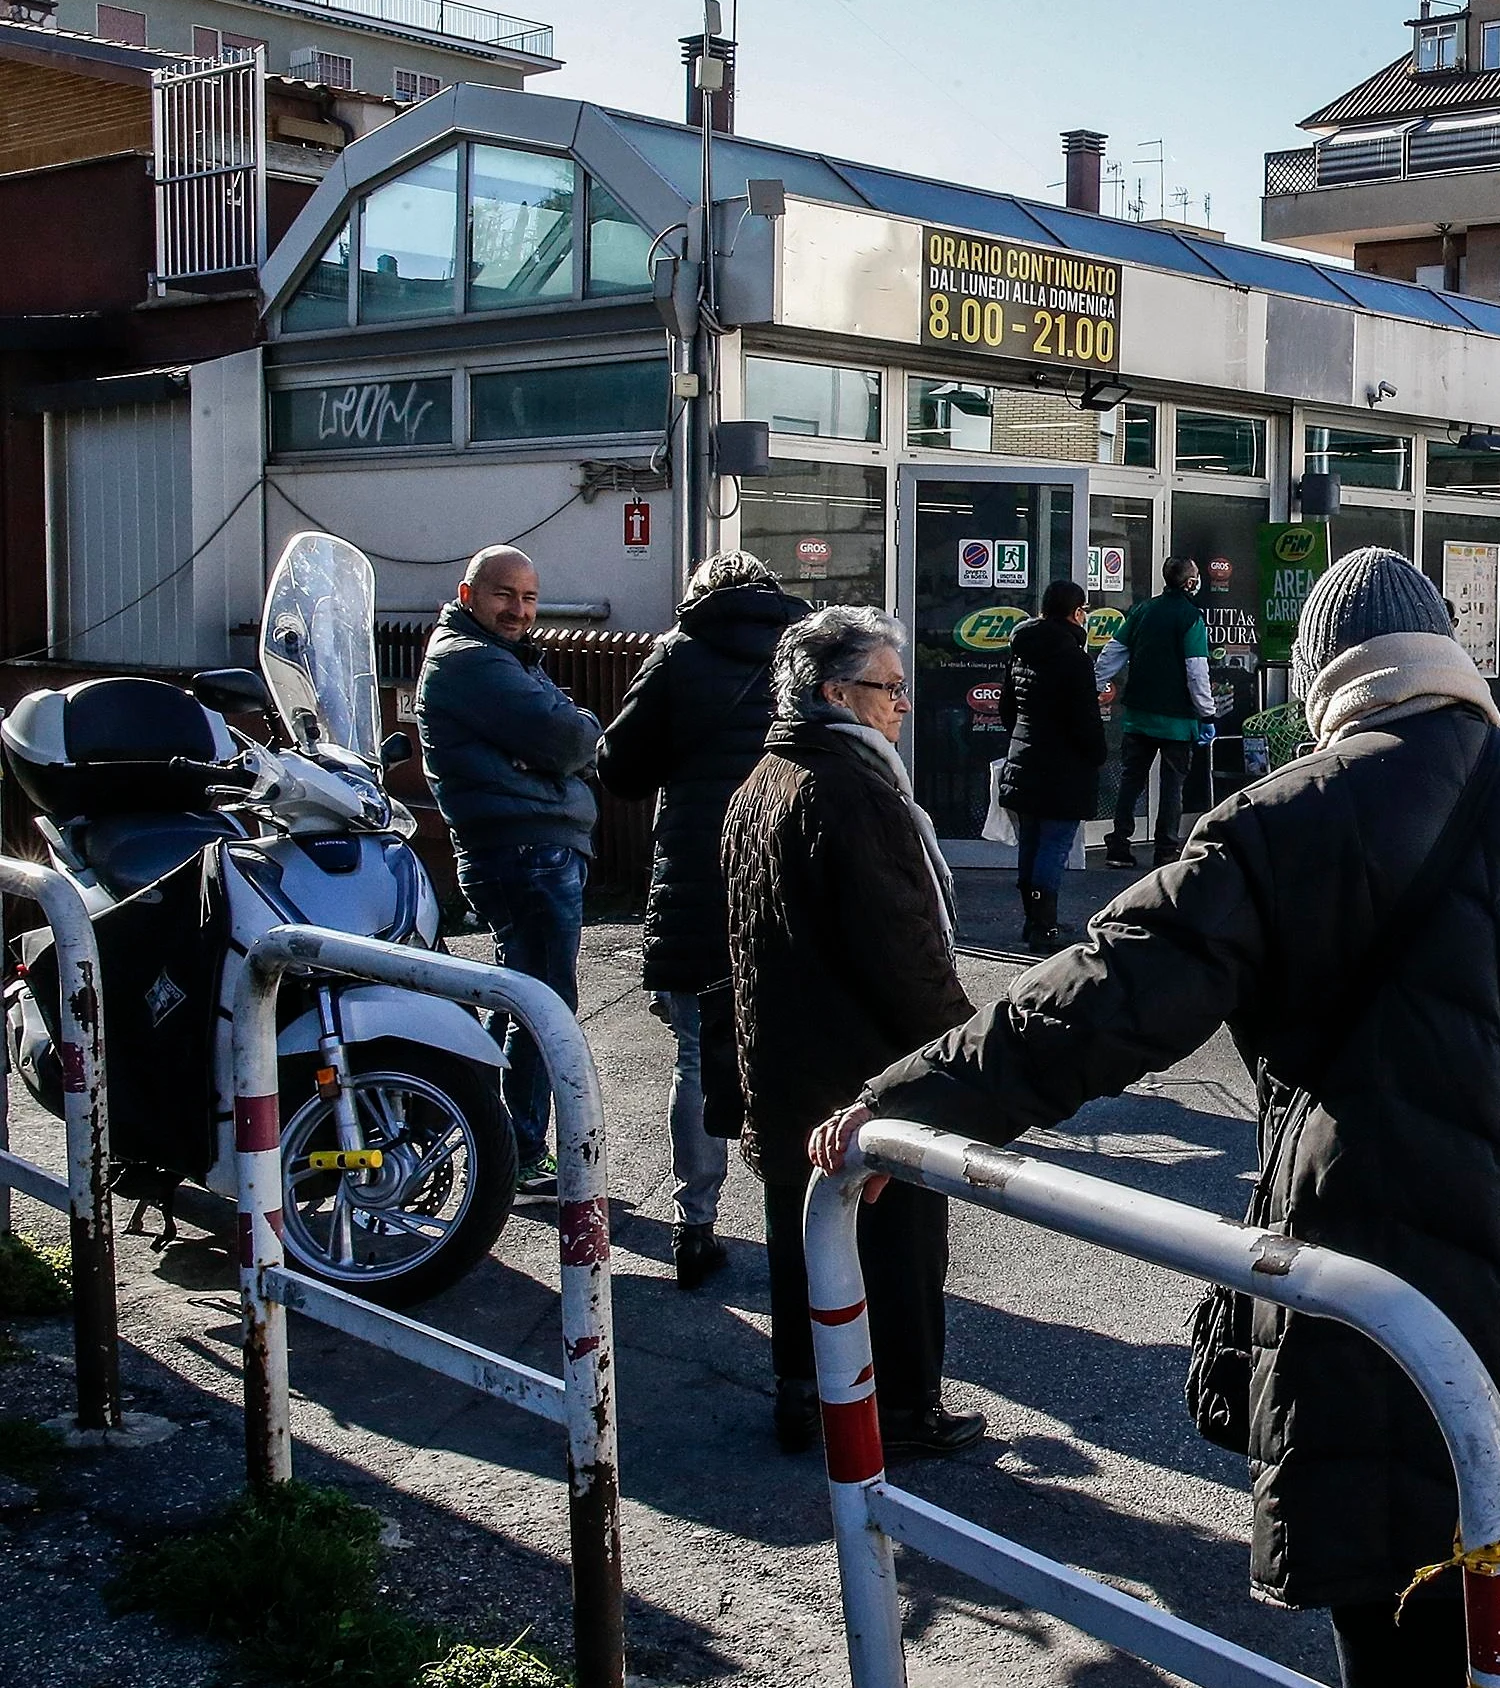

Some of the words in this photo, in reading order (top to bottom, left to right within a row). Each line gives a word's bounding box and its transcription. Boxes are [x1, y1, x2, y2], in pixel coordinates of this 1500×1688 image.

[929, 234, 1002, 276] ORARIO
[1006, 249, 1116, 296] CONTINUATO
[930, 266, 957, 293] DAL
[961, 270, 1009, 301] LUNEDI
[1012, 281, 1047, 308] ALLA
[1050, 288, 1116, 319] DOMENICA
[929, 292, 1003, 347] 8.00
[1033, 310, 1114, 363] 21.00
[800, 543, 827, 553] GROS
[1280, 534, 1313, 553] PiM
[1210, 562, 1230, 571] GROS
[1273, 569, 1315, 598] AREA
[1199, 608, 1256, 627] UTTA&
[1205, 626, 1258, 644] RDURA
[972, 688, 1002, 700] GRO
